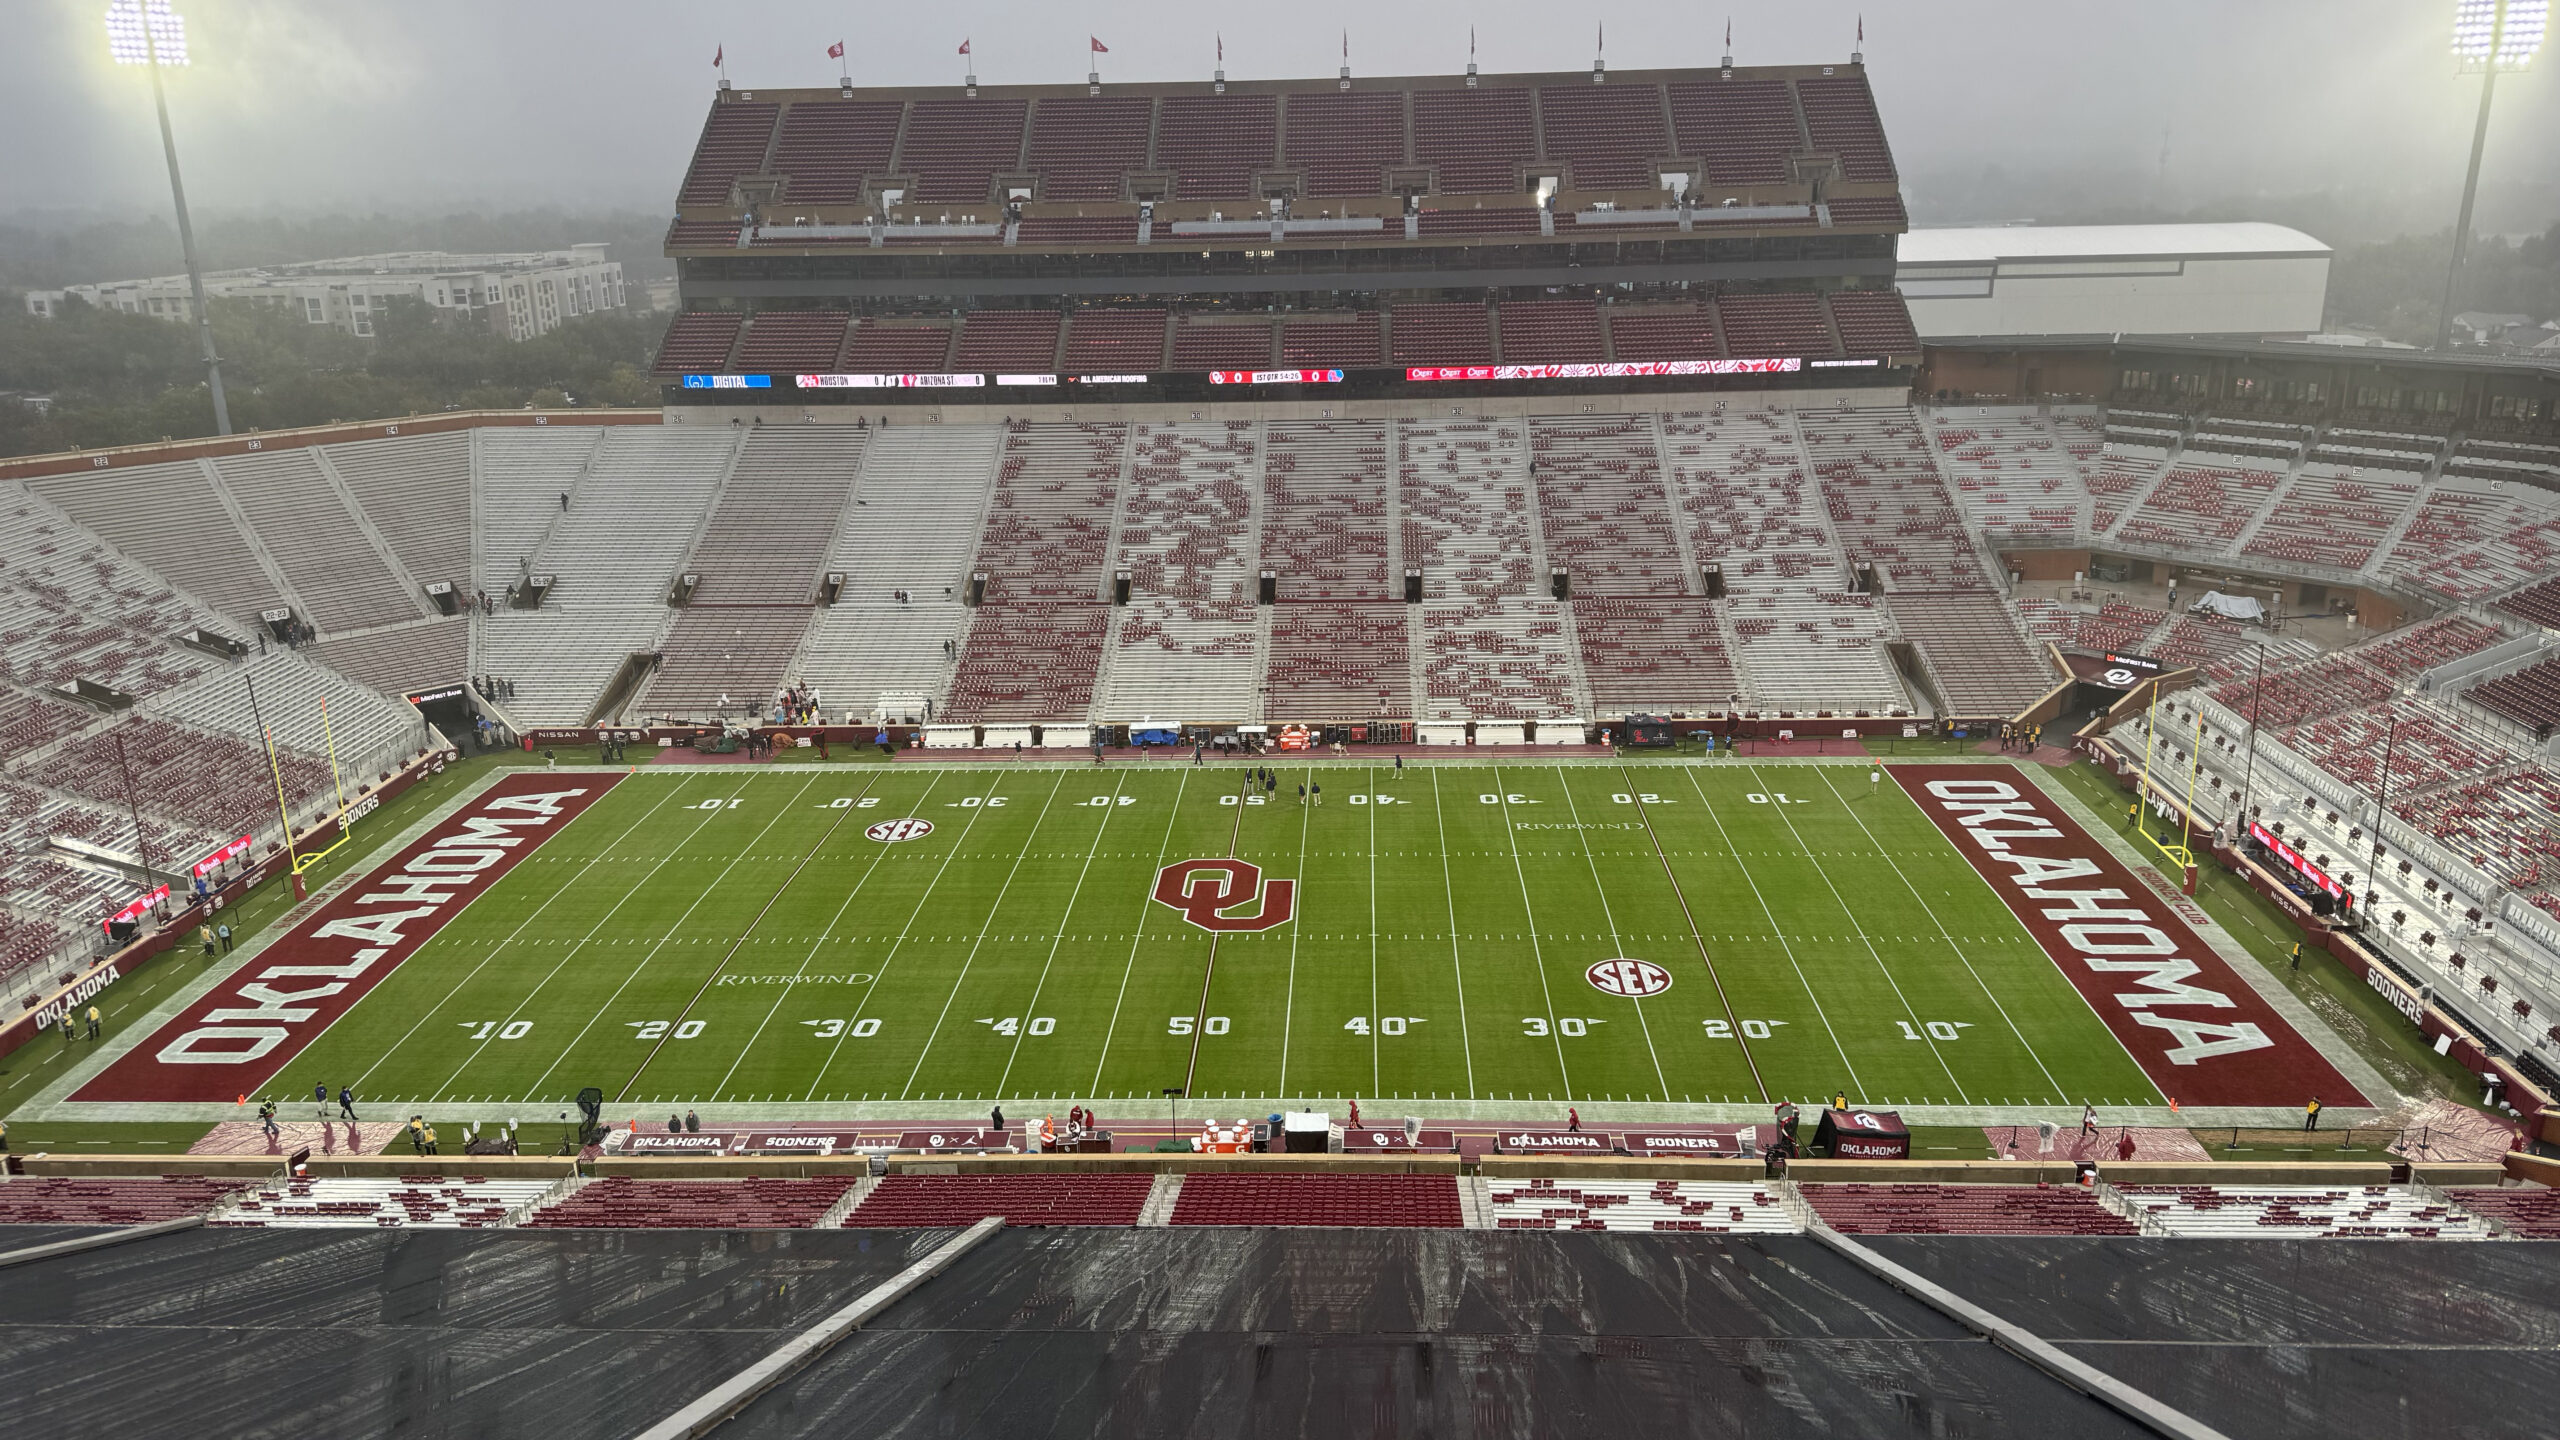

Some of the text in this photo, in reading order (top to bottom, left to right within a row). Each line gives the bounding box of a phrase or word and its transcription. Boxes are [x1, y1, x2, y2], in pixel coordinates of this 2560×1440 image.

[713, 375, 748, 389] DIGITAL
[820, 375, 849, 387] HOUSTON
[1452, 407, 1463, 415] 32
[1584, 404, 1594, 413] 33
[1715, 401, 1726, 410] 34
[1192, 411, 1201, 420] 30
[1322, 409, 1333, 418] 31
[249, 441, 261, 449] 23
[94, 458, 108, 466] 22
[2491, 481, 2502, 490] 40
[434, 584, 443, 592] 24
[265, 610, 286, 619] 22-23
[2103, 668, 2137, 685] OU
[338, 794, 379, 831] SOONERS
[868, 819, 932, 842] SEC
[1516, 822, 1645, 831] RIVERWIND
[1152, 858, 1297, 932] OU
[2141, 872, 2209, 924] SOONER CLUB
[2271, 891, 2299, 918] NISSAN
[156, 788, 588, 1064] OKLAHOMA
[1924, 780, 2276, 1065] OKLAHOMA
[715, 973, 874, 986] RIVERWIND
[1589, 960, 1669, 996] SEC
[35, 964, 121, 1031] OKLAHOMA
[2367, 967, 2423, 1026] SOONERS
[470, 1021, 534, 1040] 10
[635, 1020, 708, 1039] 20
[813, 1019, 882, 1038] 30
[992, 1017, 1057, 1036] 40
[1168, 1016, 1230, 1036] 50
[1344, 1016, 1407, 1036] 40
[1522, 1017, 1587, 1037] 30
[1702, 1019, 1771, 1039] 20
[1896, 1020, 1960, 1041] 10
[634, 1136, 722, 1147] OKLAHOMA
[765, 1136, 837, 1147] SOONERS
[929, 1134, 945, 1147] OU
[1373, 1133, 1388, 1146] OU
[1645, 1137, 1719, 1148] SOONERS
[1206, 1144, 1217, 1153] G
[1235, 1144, 1245, 1153] G
[1840, 1143, 1902, 1156] OKLAHOMA
